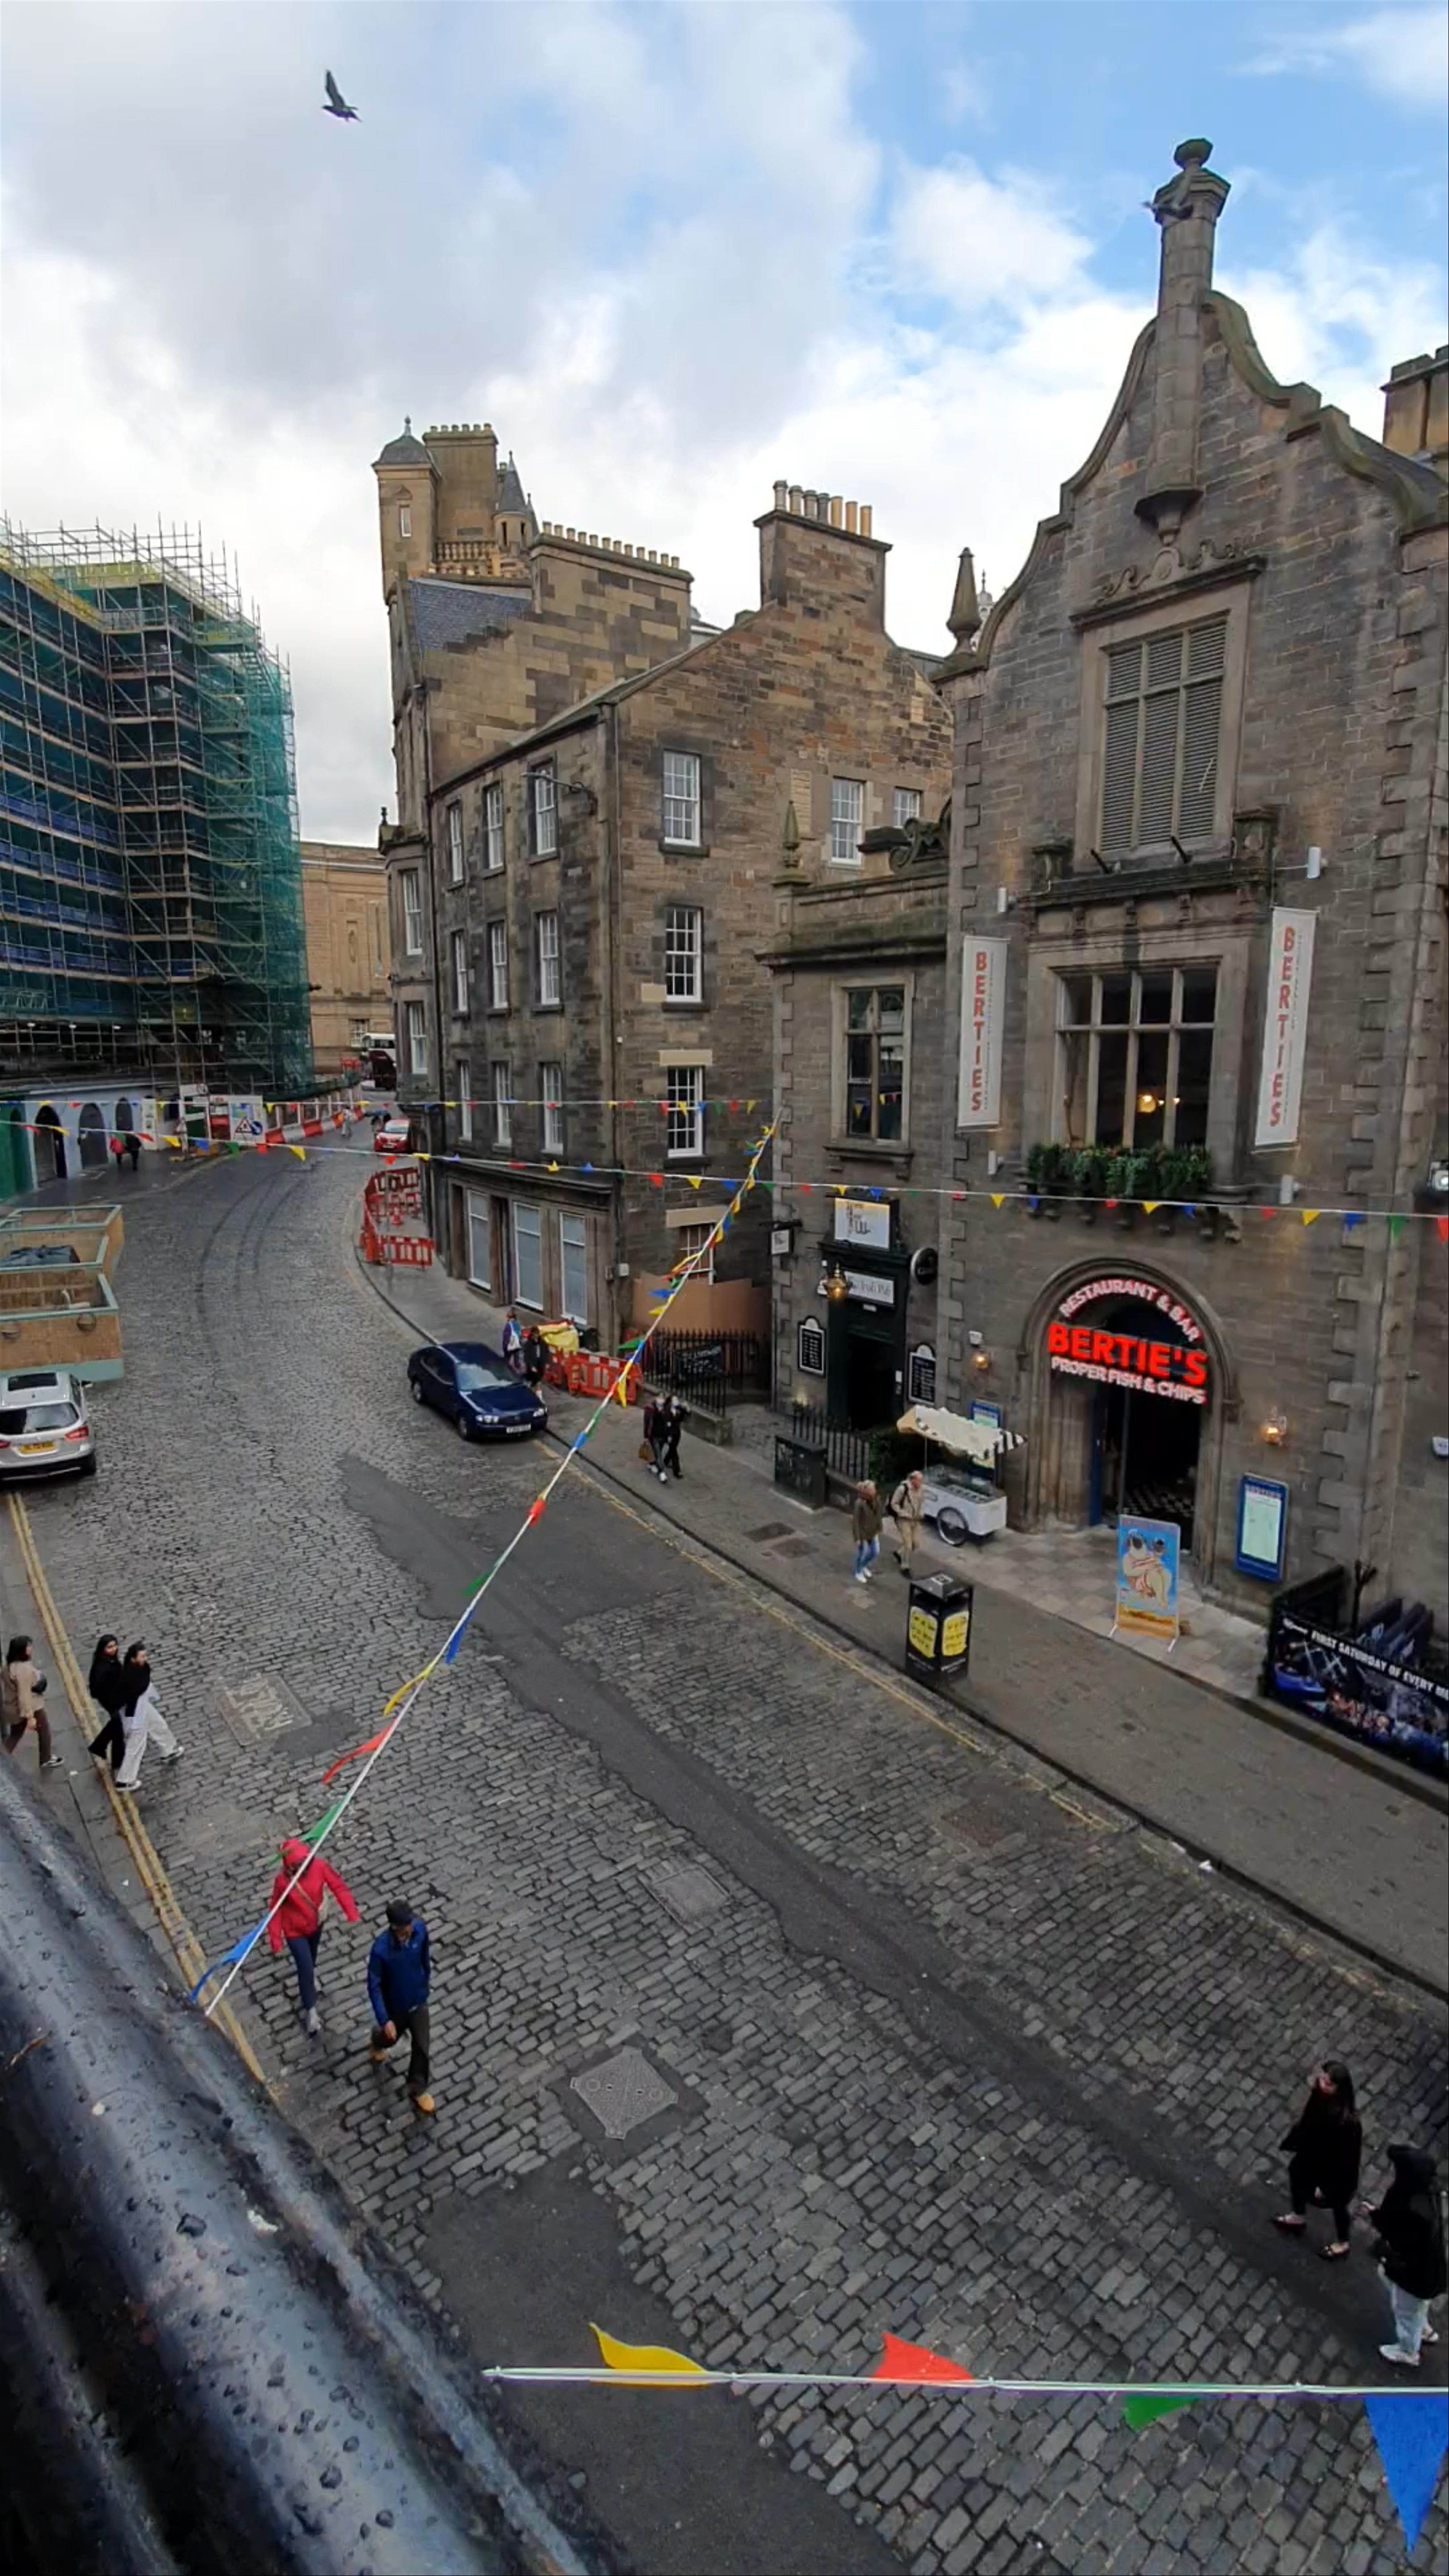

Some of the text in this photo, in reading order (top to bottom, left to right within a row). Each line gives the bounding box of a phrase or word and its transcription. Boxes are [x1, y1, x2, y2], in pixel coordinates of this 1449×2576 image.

[971, 952, 987, 1111] BERTIES
[1270, 927, 1295, 1127] BERTIES
[1059, 1279, 1202, 1342] RESTAURANT & BAR
[1048, 1322, 1208, 1386] BERTIE'S
[1051, 1356, 1208, 1405] PROPER FISH & CHIPS
[1311, 1630, 1337, 1649] FIRST
[1338, 1642, 1387, 1672] SATURDAY
[1387, 1664, 1401, 1677] OF
[1403, 1670, 1434, 1692] EVERY
